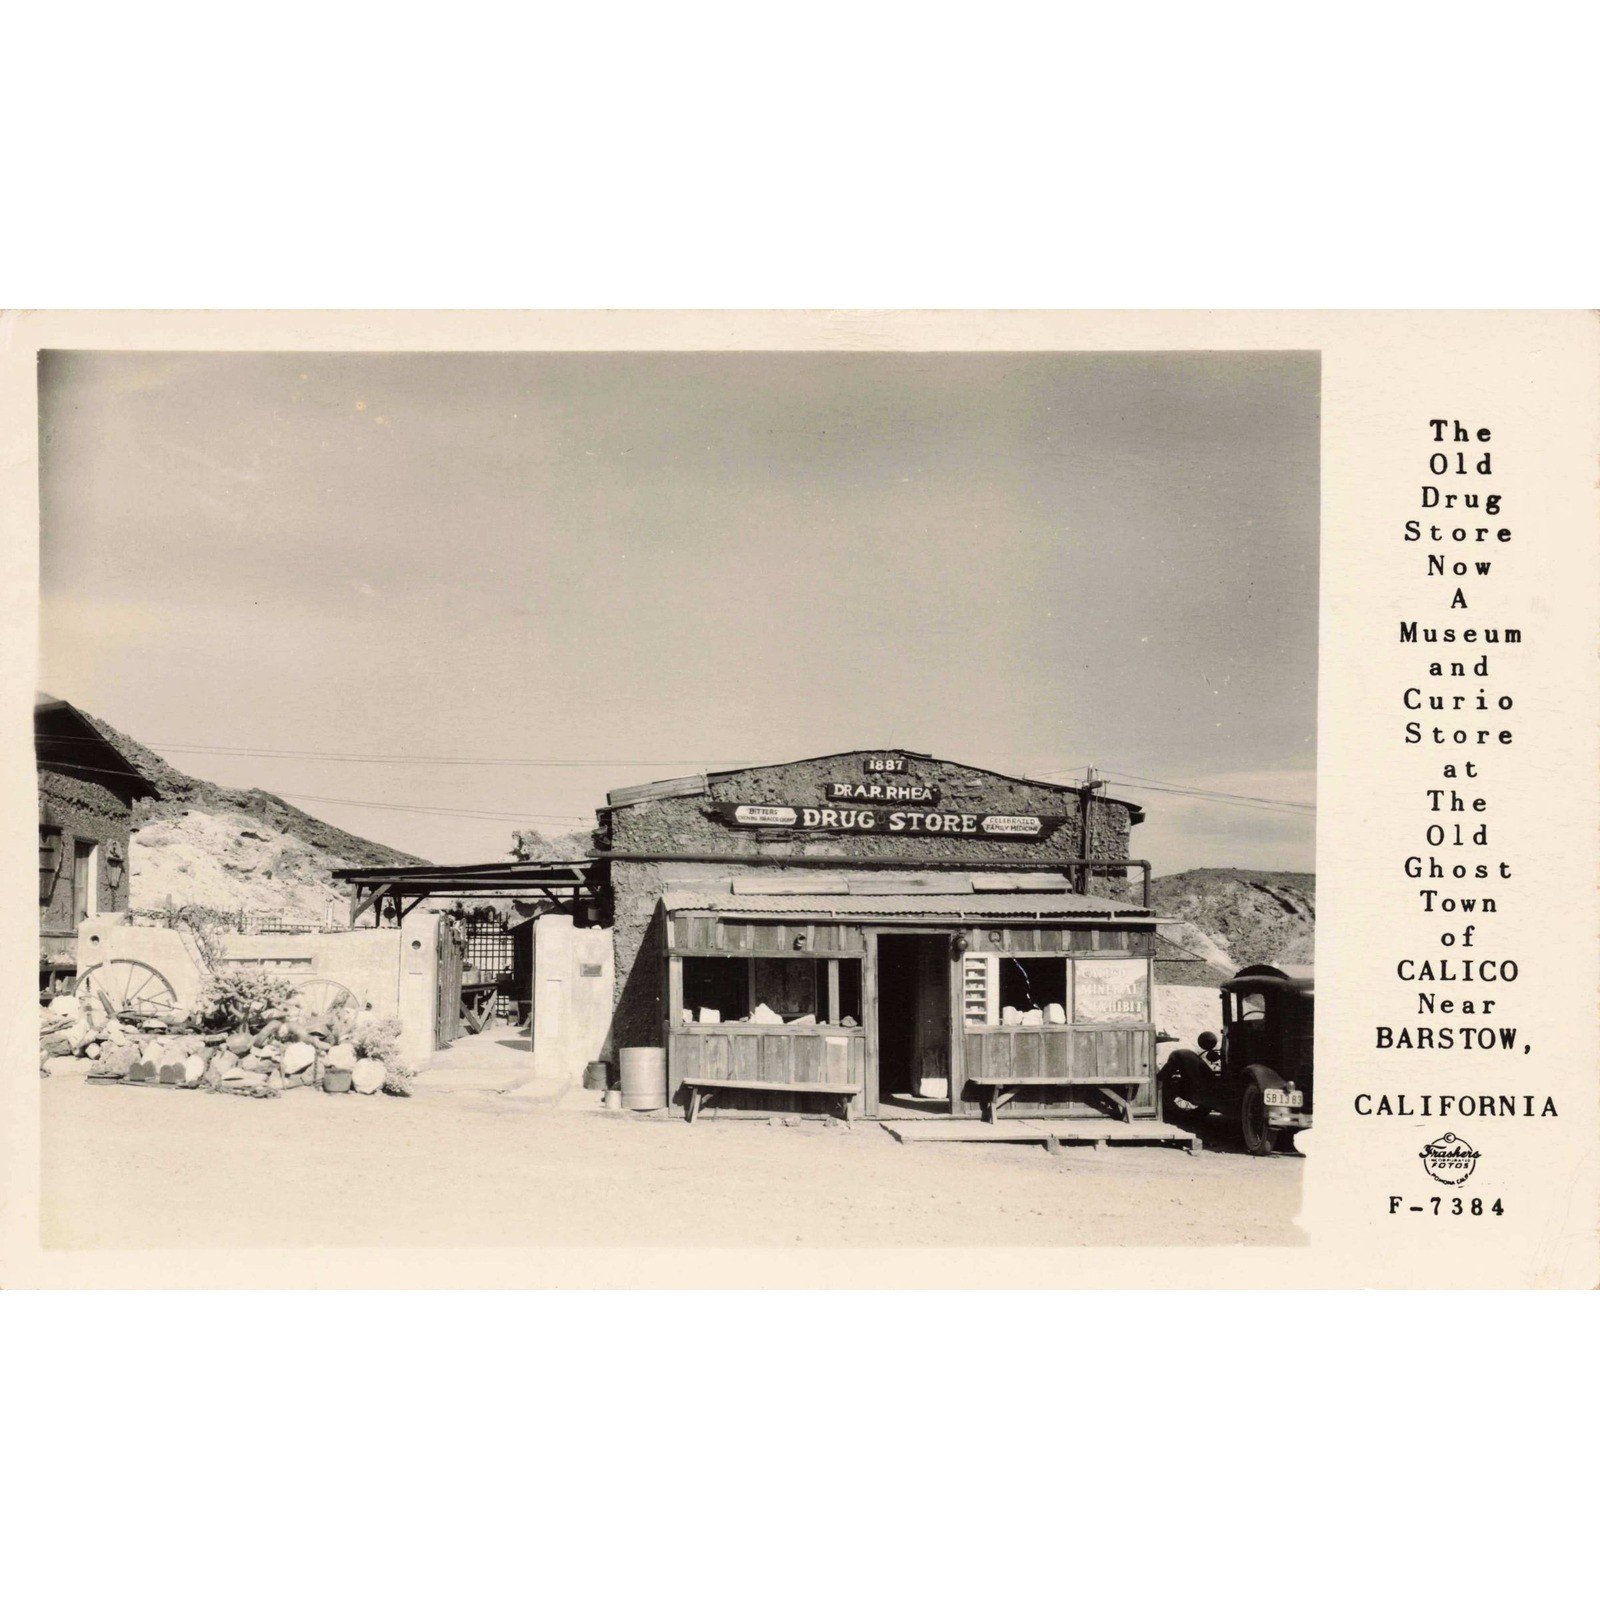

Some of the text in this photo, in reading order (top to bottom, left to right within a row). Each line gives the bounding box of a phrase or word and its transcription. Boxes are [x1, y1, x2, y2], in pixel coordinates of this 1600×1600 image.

[869, 759, 903, 771] 1887
[834, 783, 852, 796] DR
[886, 786, 932, 800] RHEA
[803, 808, 978, 833] DRUG STORE
[989, 817, 1036, 825] CELEBRATED
